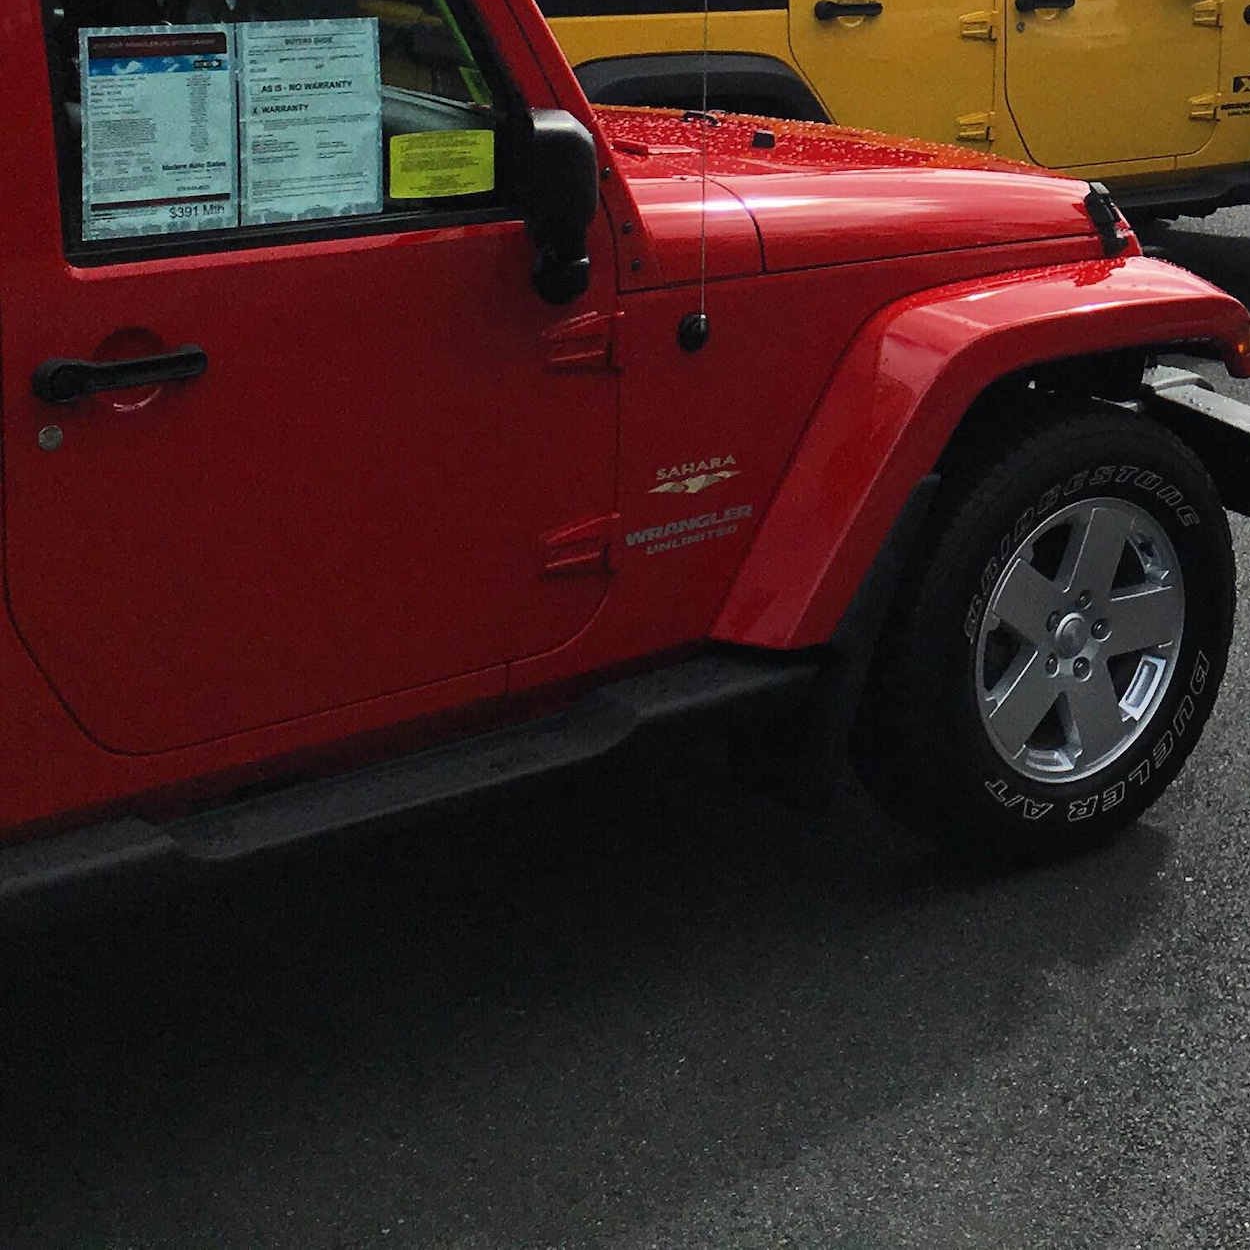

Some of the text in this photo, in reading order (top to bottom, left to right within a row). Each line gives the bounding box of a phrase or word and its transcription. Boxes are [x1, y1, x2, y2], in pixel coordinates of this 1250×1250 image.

[261, 85, 273, 93] AS
[274, 84, 283, 92] IS
[289, 83, 302, 92] NO
[304, 80, 352, 90] WARRANTY
[261, 103, 309, 113] WARRANTY
[162, 163, 187, 171] Modern
[169, 206, 199, 219] $391
[656, 455, 737, 480] SAHARA
[625, 504, 753, 546] WRANGLER
[645, 524, 738, 555] UNLIMITED
[963, 465, 1200, 644] BRIDGESTONE
[985, 650, 1210, 822] DUELER A/T
